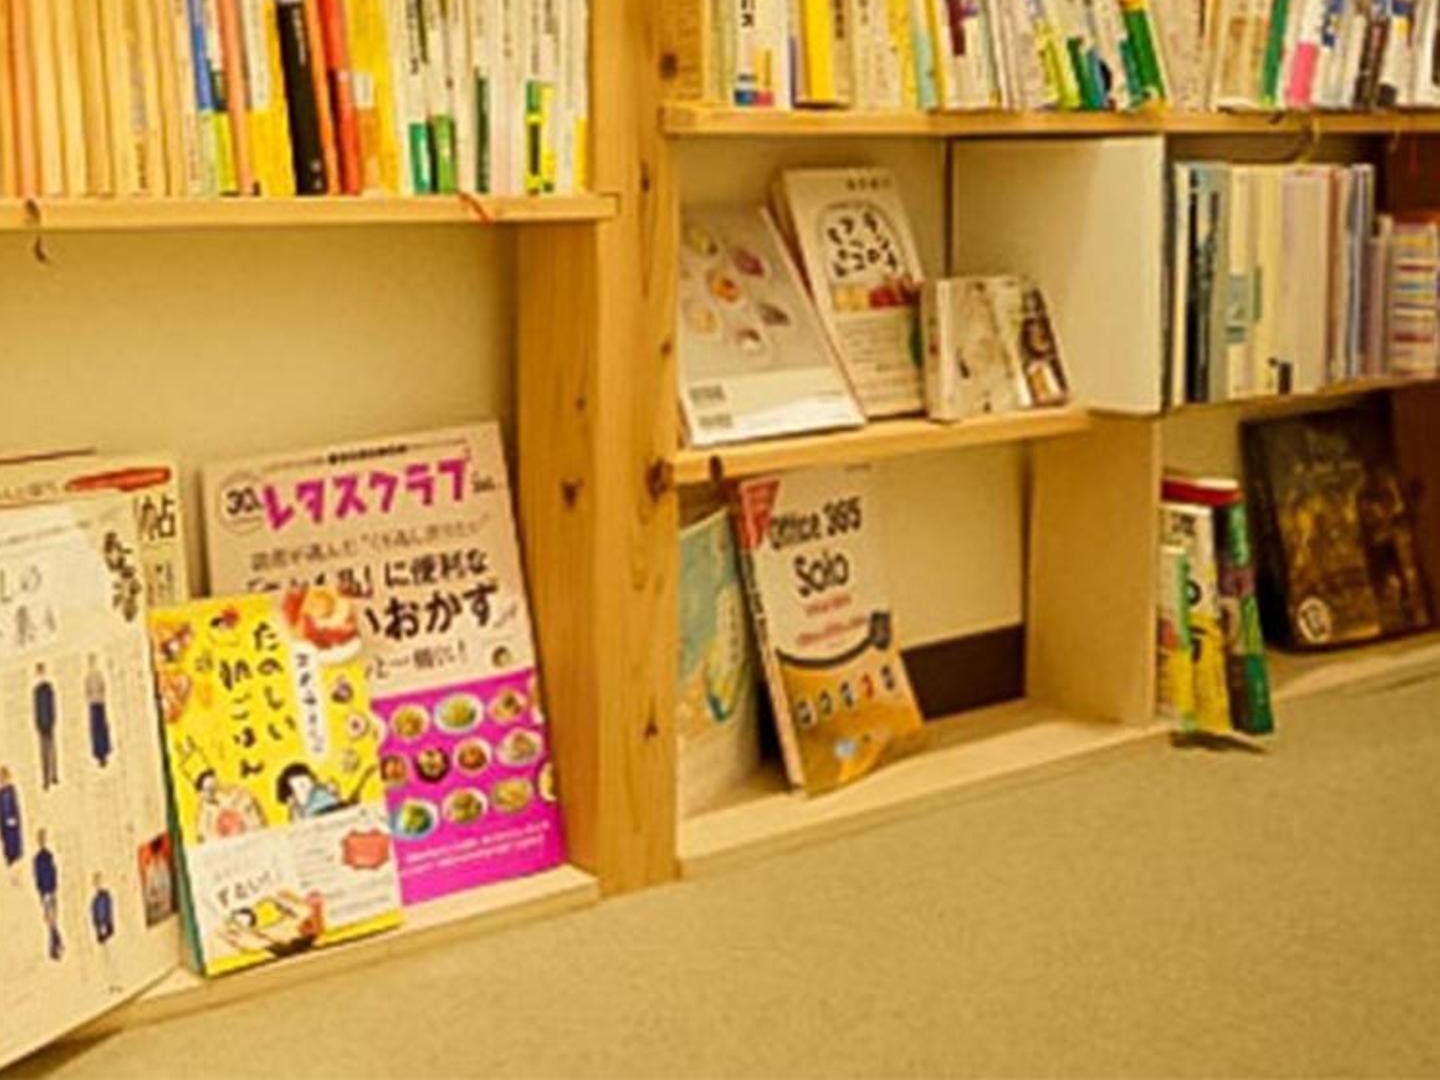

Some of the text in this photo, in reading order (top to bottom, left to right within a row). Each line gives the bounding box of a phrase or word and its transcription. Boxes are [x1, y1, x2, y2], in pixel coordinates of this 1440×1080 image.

[261, 448, 471, 532] レタスクラブ
[822, 496, 862, 537] 365
[793, 549, 850, 598] Solo
